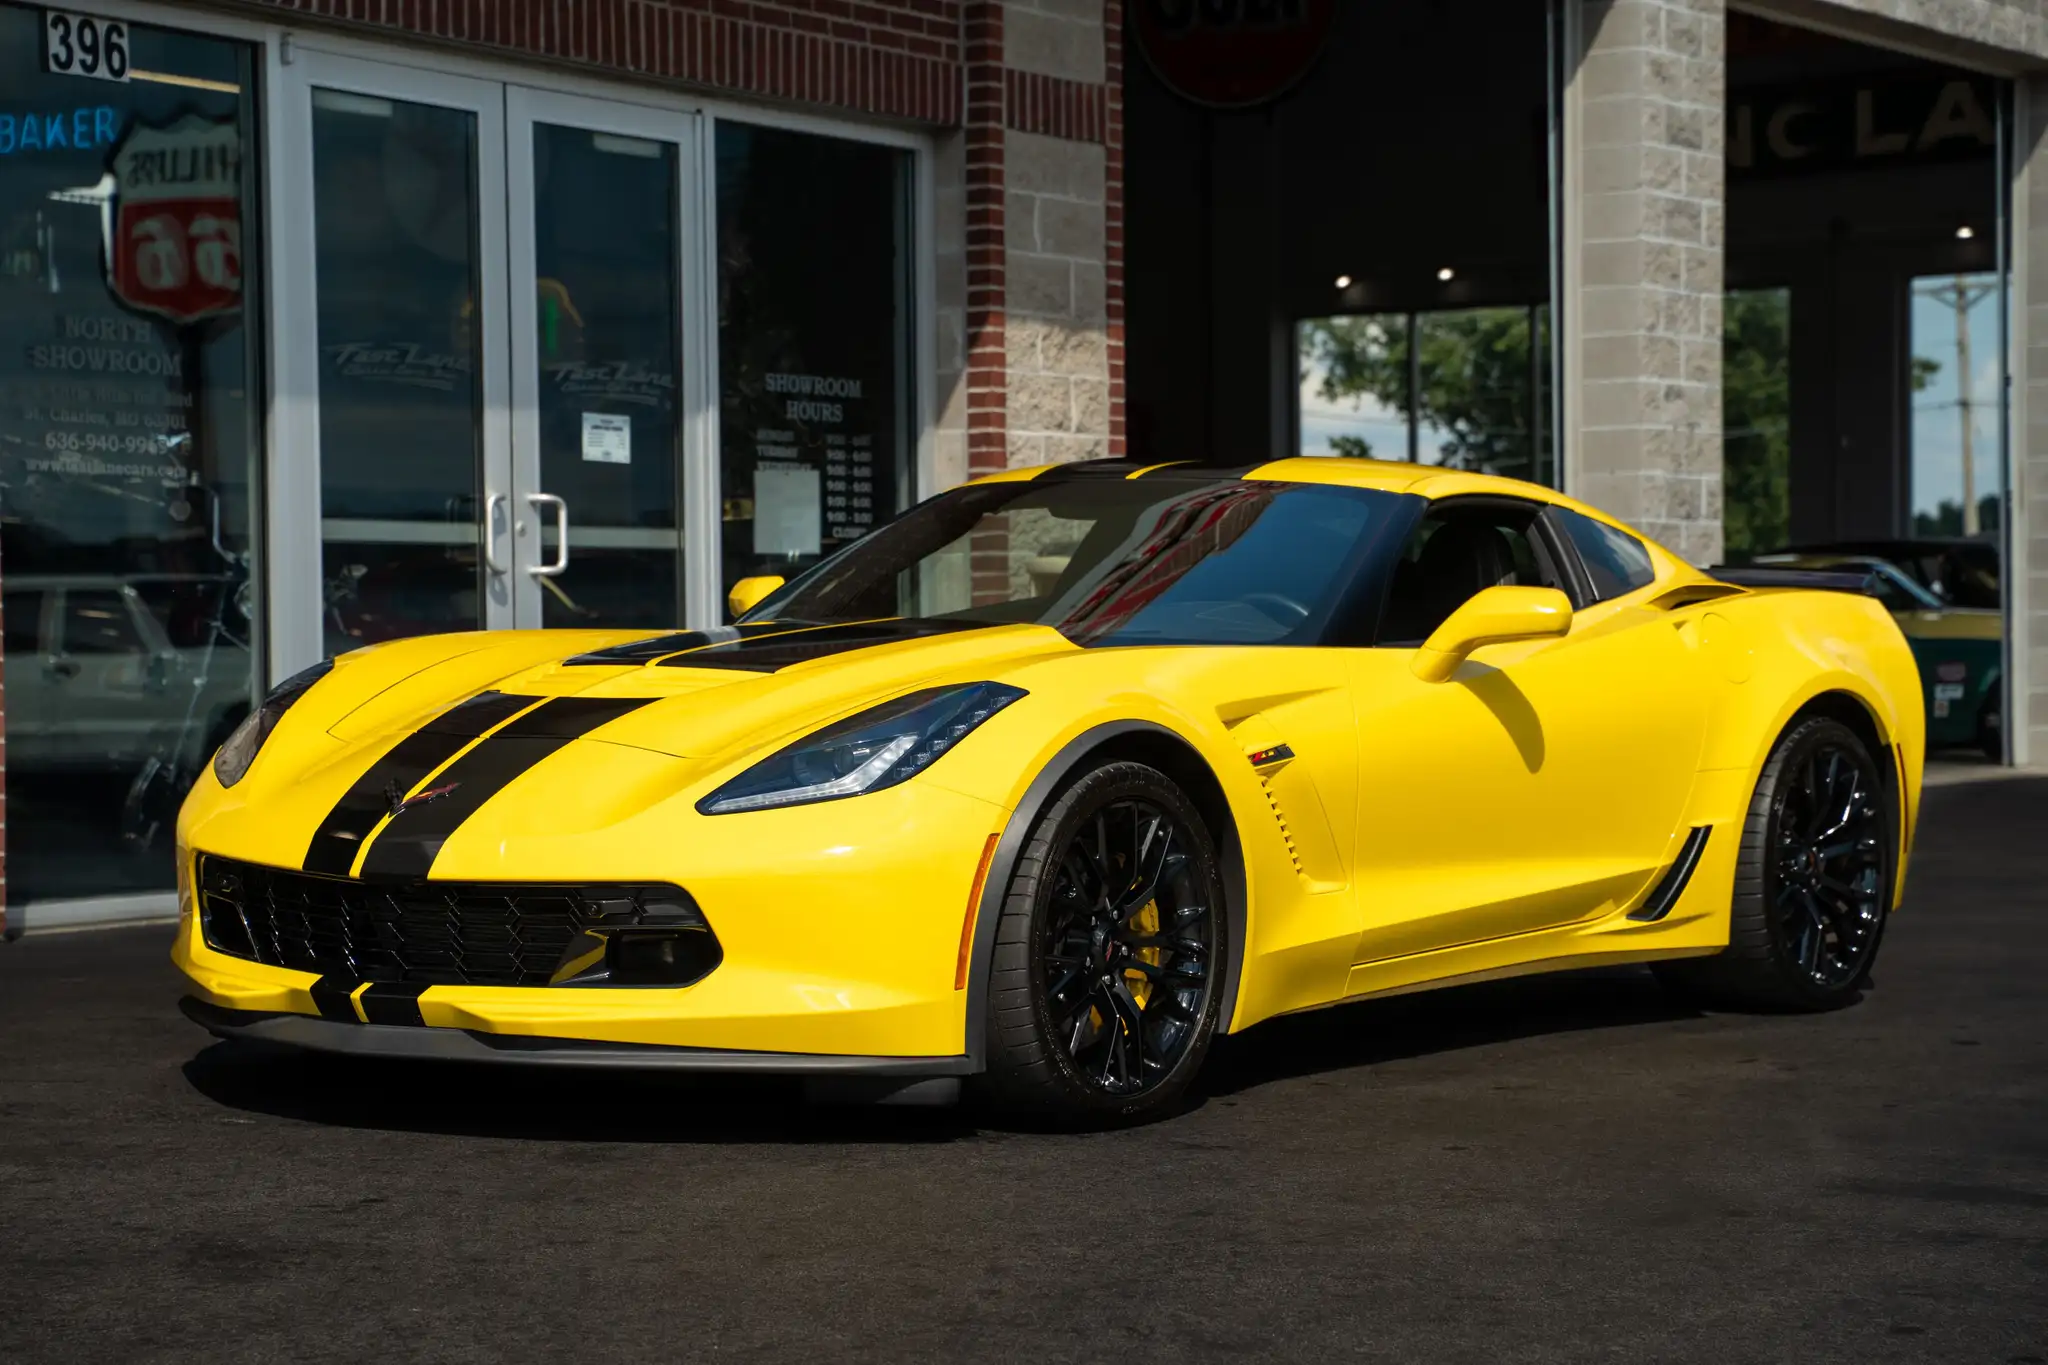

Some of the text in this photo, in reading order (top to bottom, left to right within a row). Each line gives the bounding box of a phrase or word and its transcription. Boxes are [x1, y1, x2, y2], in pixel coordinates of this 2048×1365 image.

[50, 14, 127, 79] 396
[65, 314, 152, 343] NORTH
[33, 345, 182, 377] SHOWROOM
[764, 373, 863, 398] SHOWROOM
[786, 400, 844, 422] HOURS
